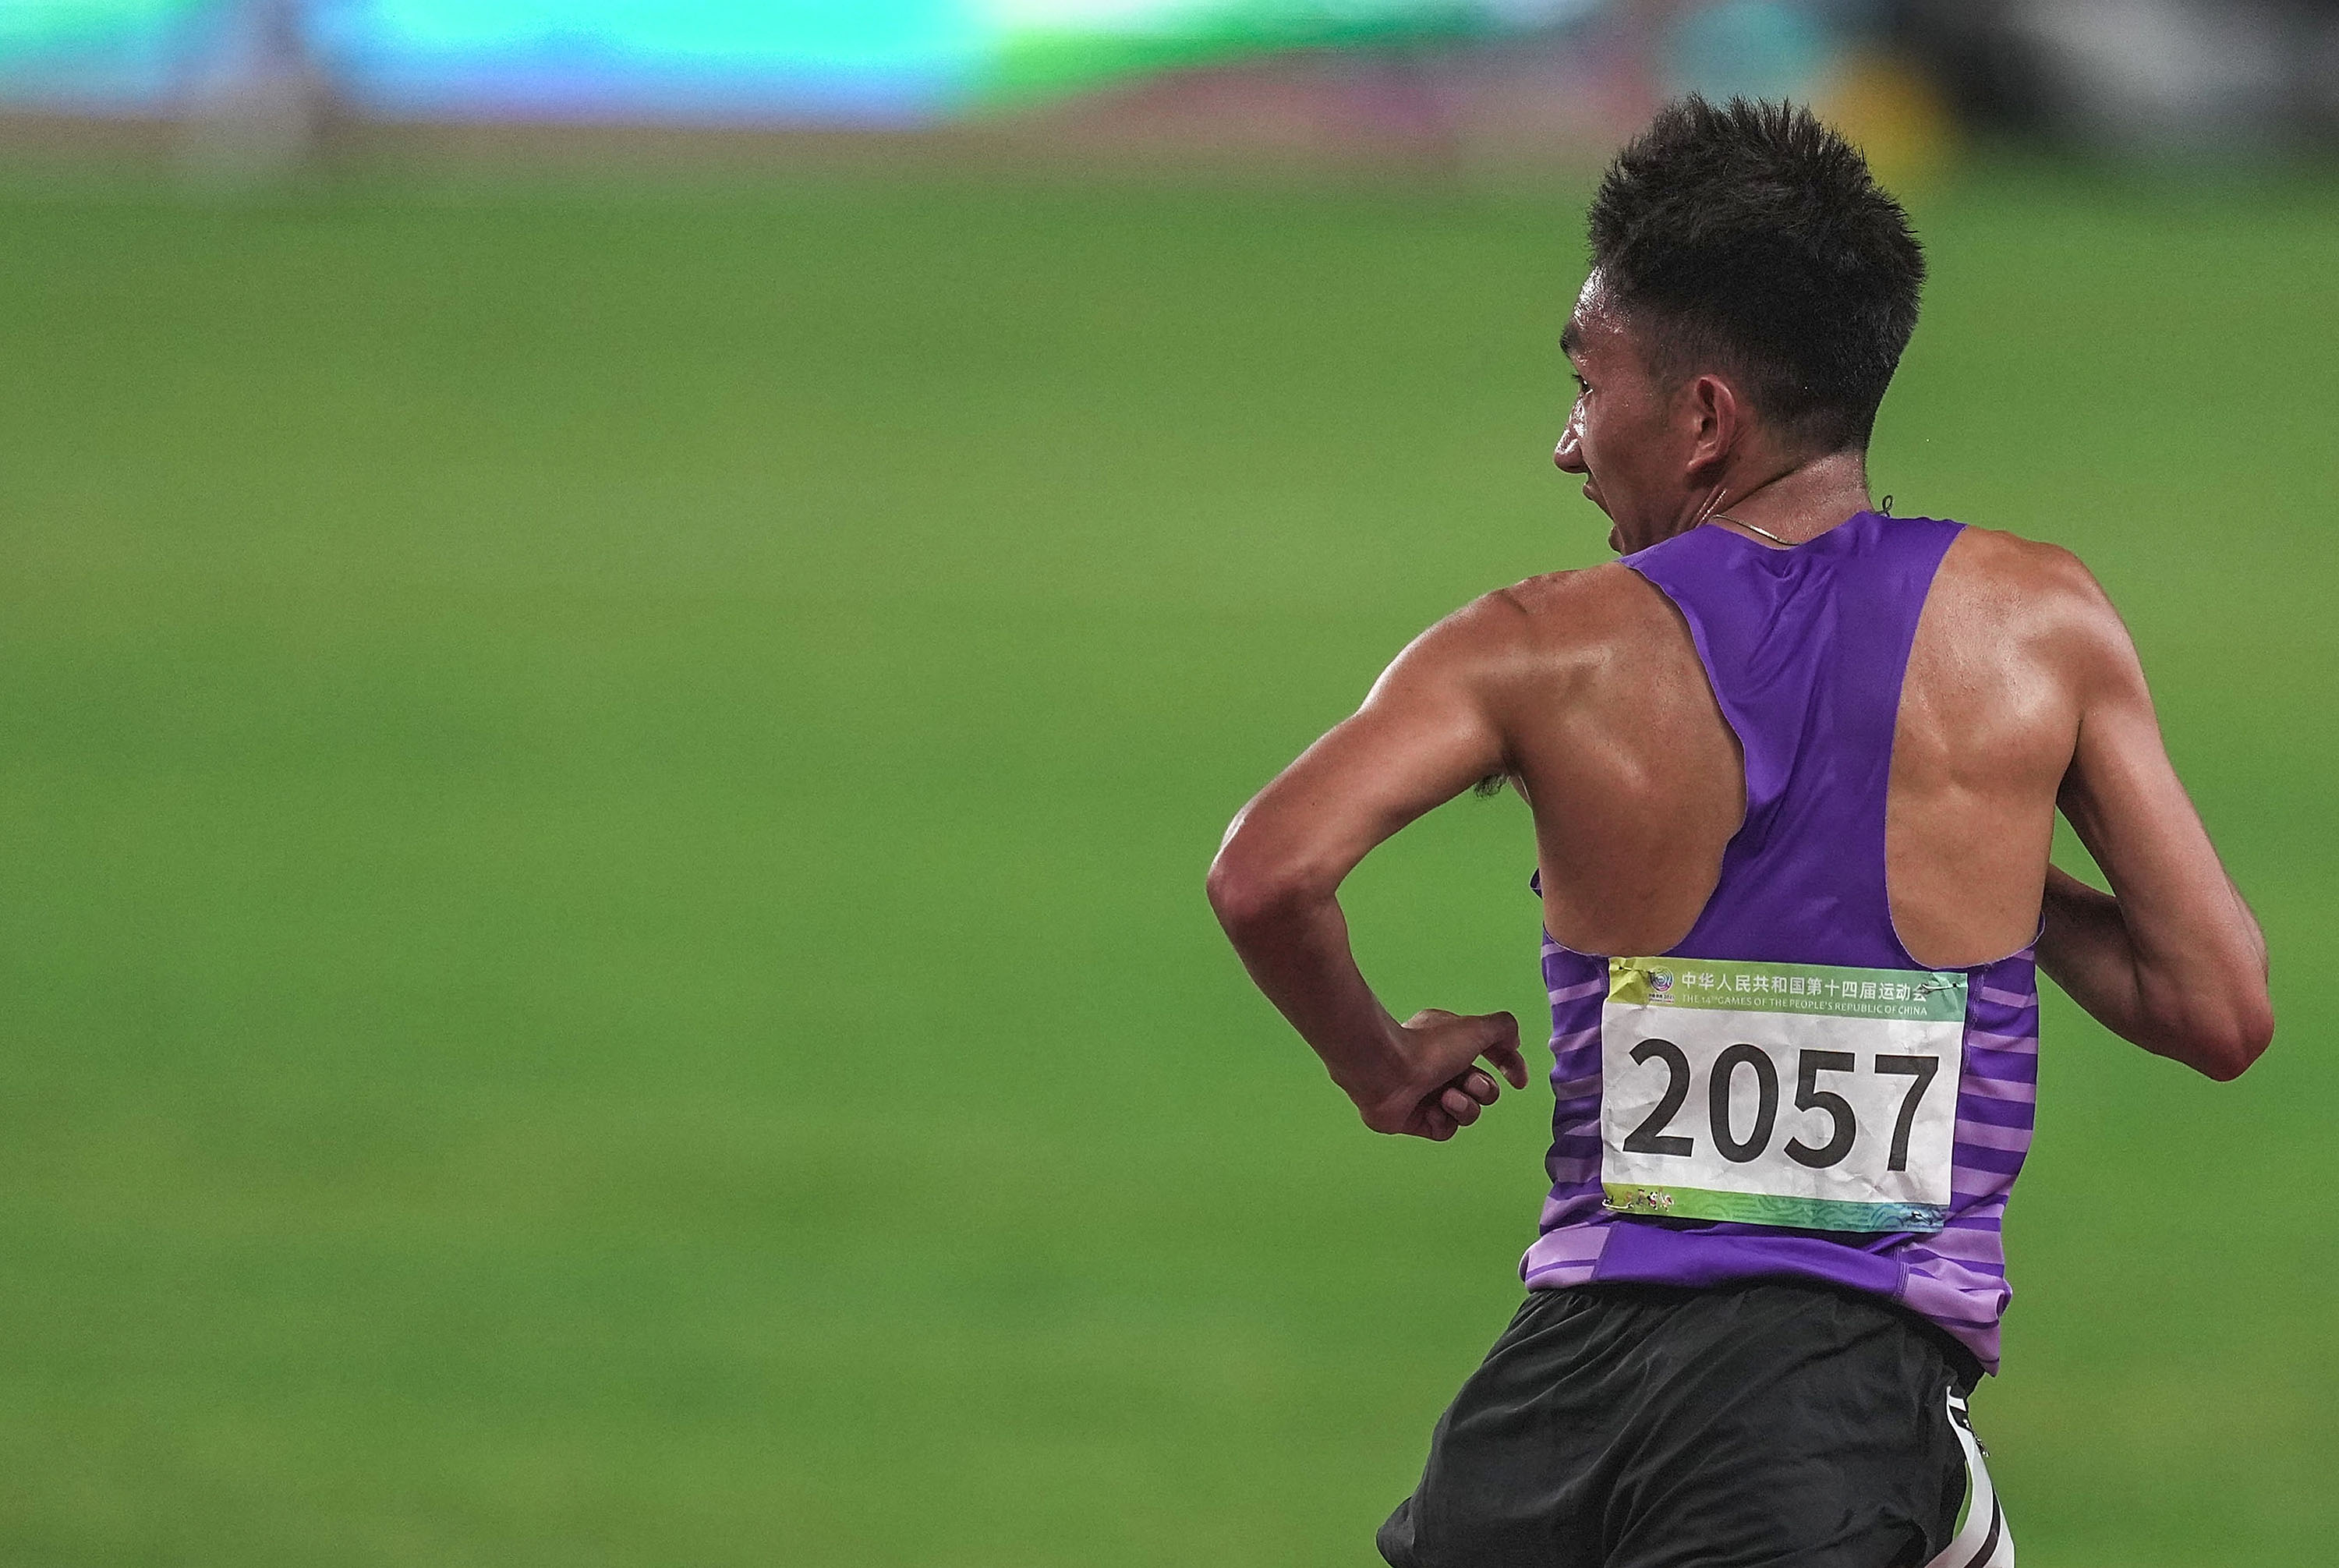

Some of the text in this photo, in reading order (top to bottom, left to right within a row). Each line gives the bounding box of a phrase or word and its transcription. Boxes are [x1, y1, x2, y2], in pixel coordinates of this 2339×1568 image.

[1681, 972, 1927, 1002] 中华人民共和国第十四届运动会
[1682, 994, 1698, 1003] THE
[1718, 996, 1752, 1006] GAMES
[1753, 998, 1766, 1007] OF
[1769, 998, 1786, 1007] THE
[1789, 999, 1833, 1011] PEOPLE'S
[1835, 1003, 1883, 1014] REPUBLIC
[1884, 1004, 1897, 1014] OF
[1898, 1005, 1928, 1015] CHINA
[1622, 1039, 1939, 1172] 2057
